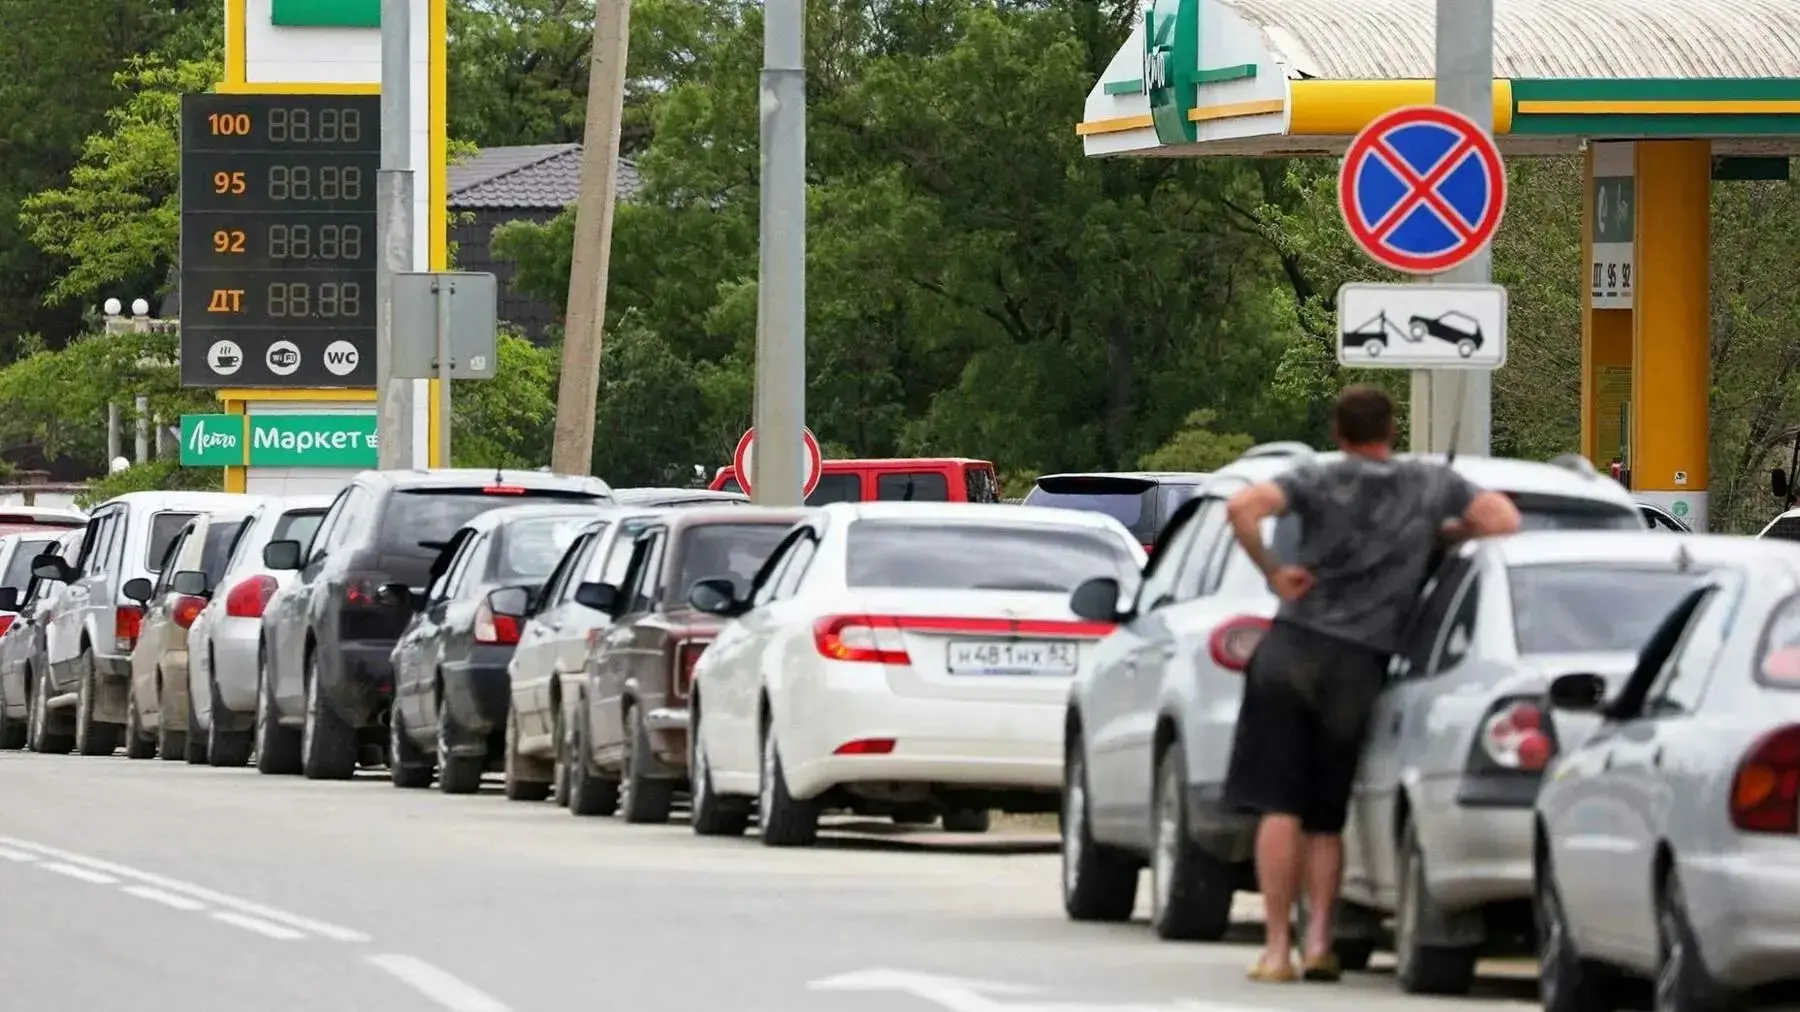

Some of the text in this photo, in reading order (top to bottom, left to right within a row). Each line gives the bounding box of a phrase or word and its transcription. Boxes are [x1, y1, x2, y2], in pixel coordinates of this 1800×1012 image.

[208, 114, 250, 135] 100
[214, 172, 246, 194] 95
[213, 231, 246, 252] 92
[1607, 262, 1617, 288] 95
[1621, 262, 1631, 288] 92
[207, 289, 244, 312] ДТ
[328, 351, 356, 364] WC
[189, 419, 362, 455] Лето Маркет
